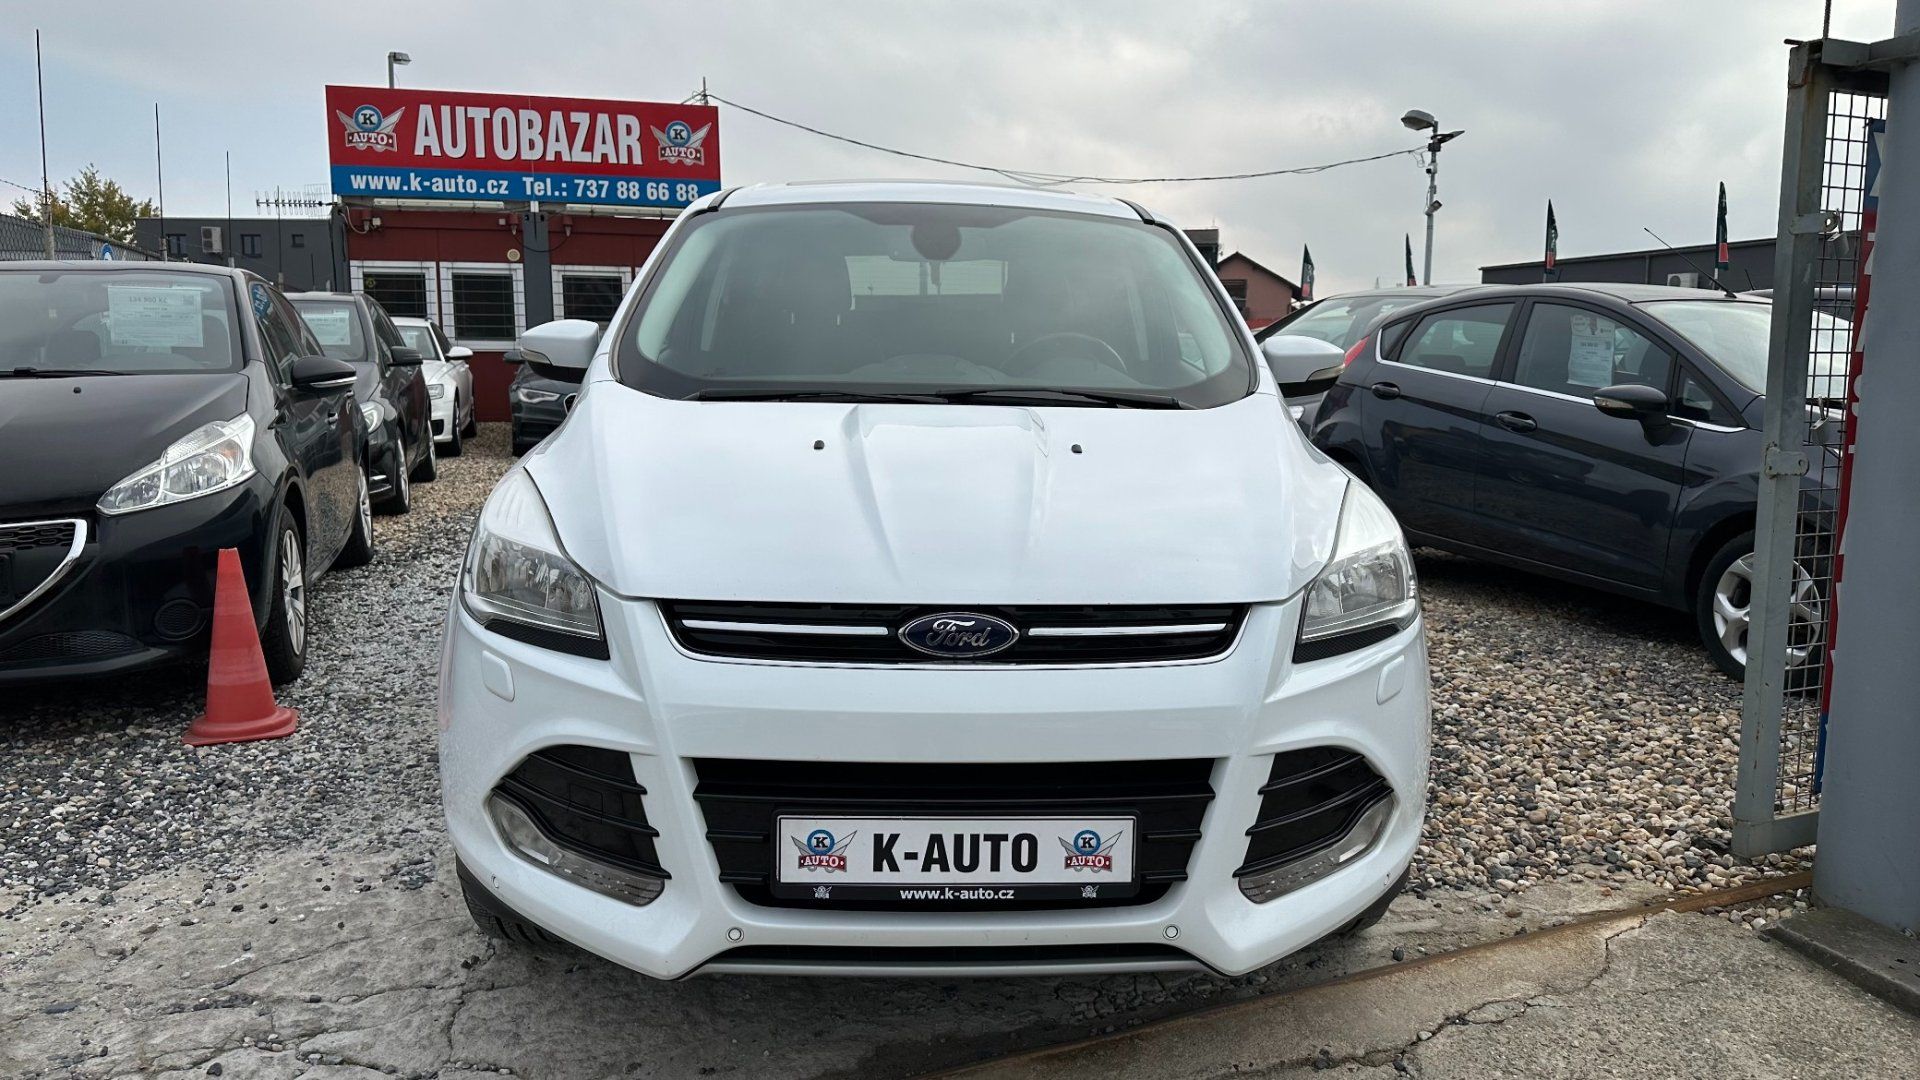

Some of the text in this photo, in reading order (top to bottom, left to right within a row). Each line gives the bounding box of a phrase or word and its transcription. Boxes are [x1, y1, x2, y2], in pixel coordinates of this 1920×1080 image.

[361, 113, 375, 125] K
[352, 132, 388, 145] AUTO
[414, 104, 643, 165] AUTOBAZAR
[672, 128, 685, 140] K
[665, 147, 696, 159] AUTO
[350, 172, 699, 202] www.k-auto.cz Tel.: 737 88 66 88
[926, 619, 992, 647] Ford
[814, 836, 828, 849] K
[1080, 837, 1095, 849] K
[873, 833, 1039, 873] K-AUTO
[803, 855, 839, 868] AUTO
[1070, 856, 1105, 867] AUTO
[899, 887, 1015, 900] www.k-auto.cz
